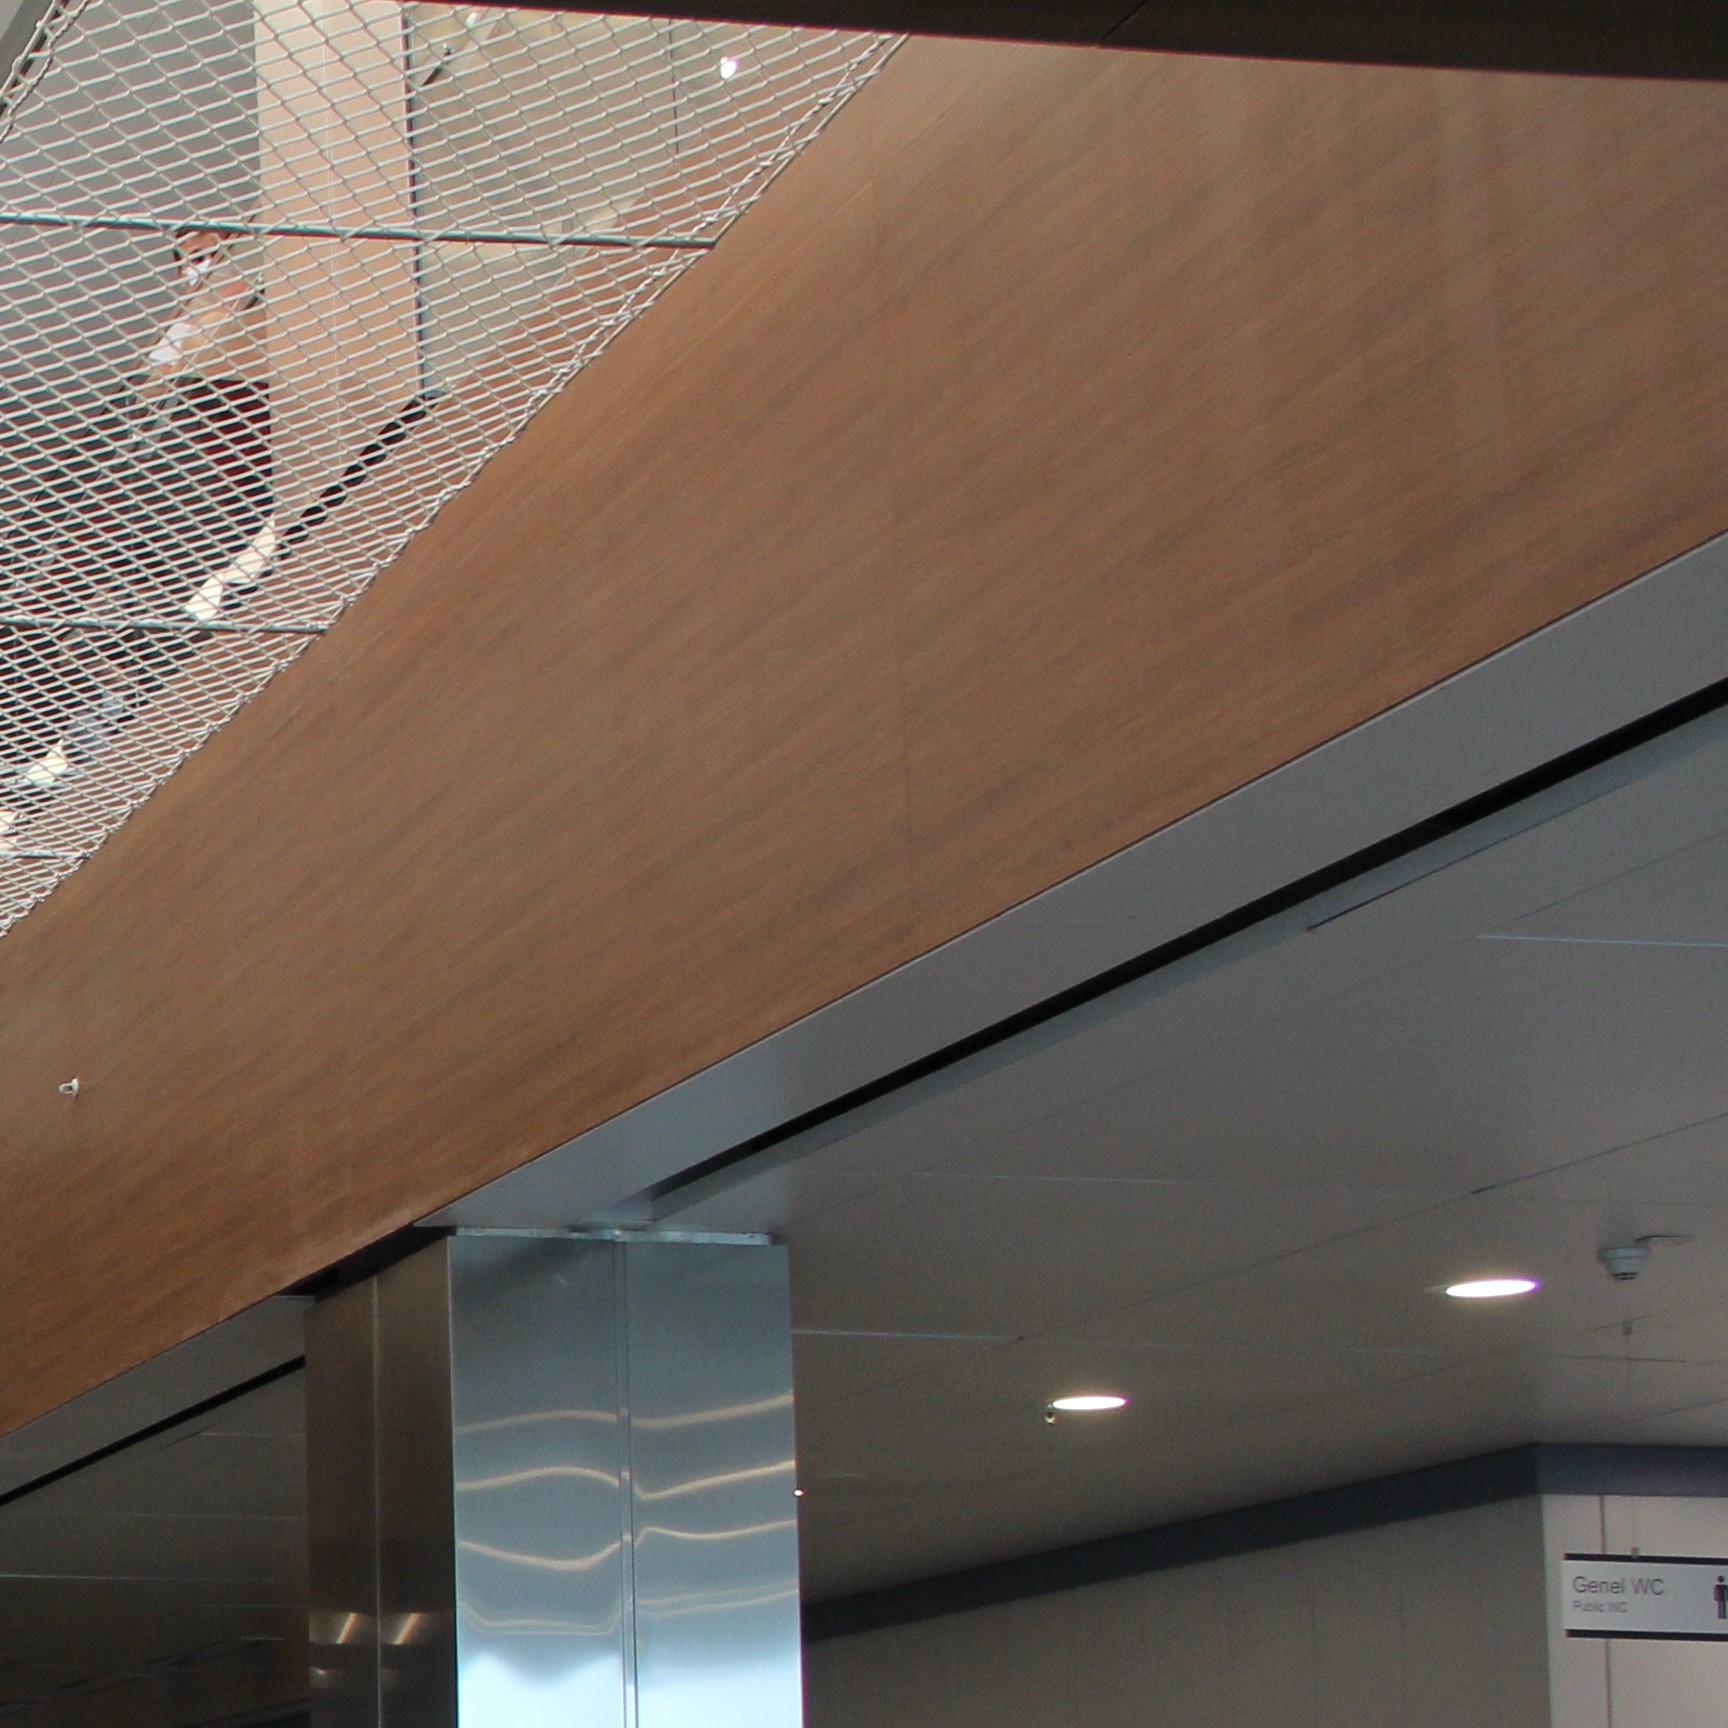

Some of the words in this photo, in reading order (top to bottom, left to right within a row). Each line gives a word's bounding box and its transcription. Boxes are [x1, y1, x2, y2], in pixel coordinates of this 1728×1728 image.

[1572, 1576, 1625, 1594] Genel
[1631, 1578, 1664, 1596] WC
[1572, 1601, 1604, 1612] Public
[1608, 1602, 1628, 1613] WC
